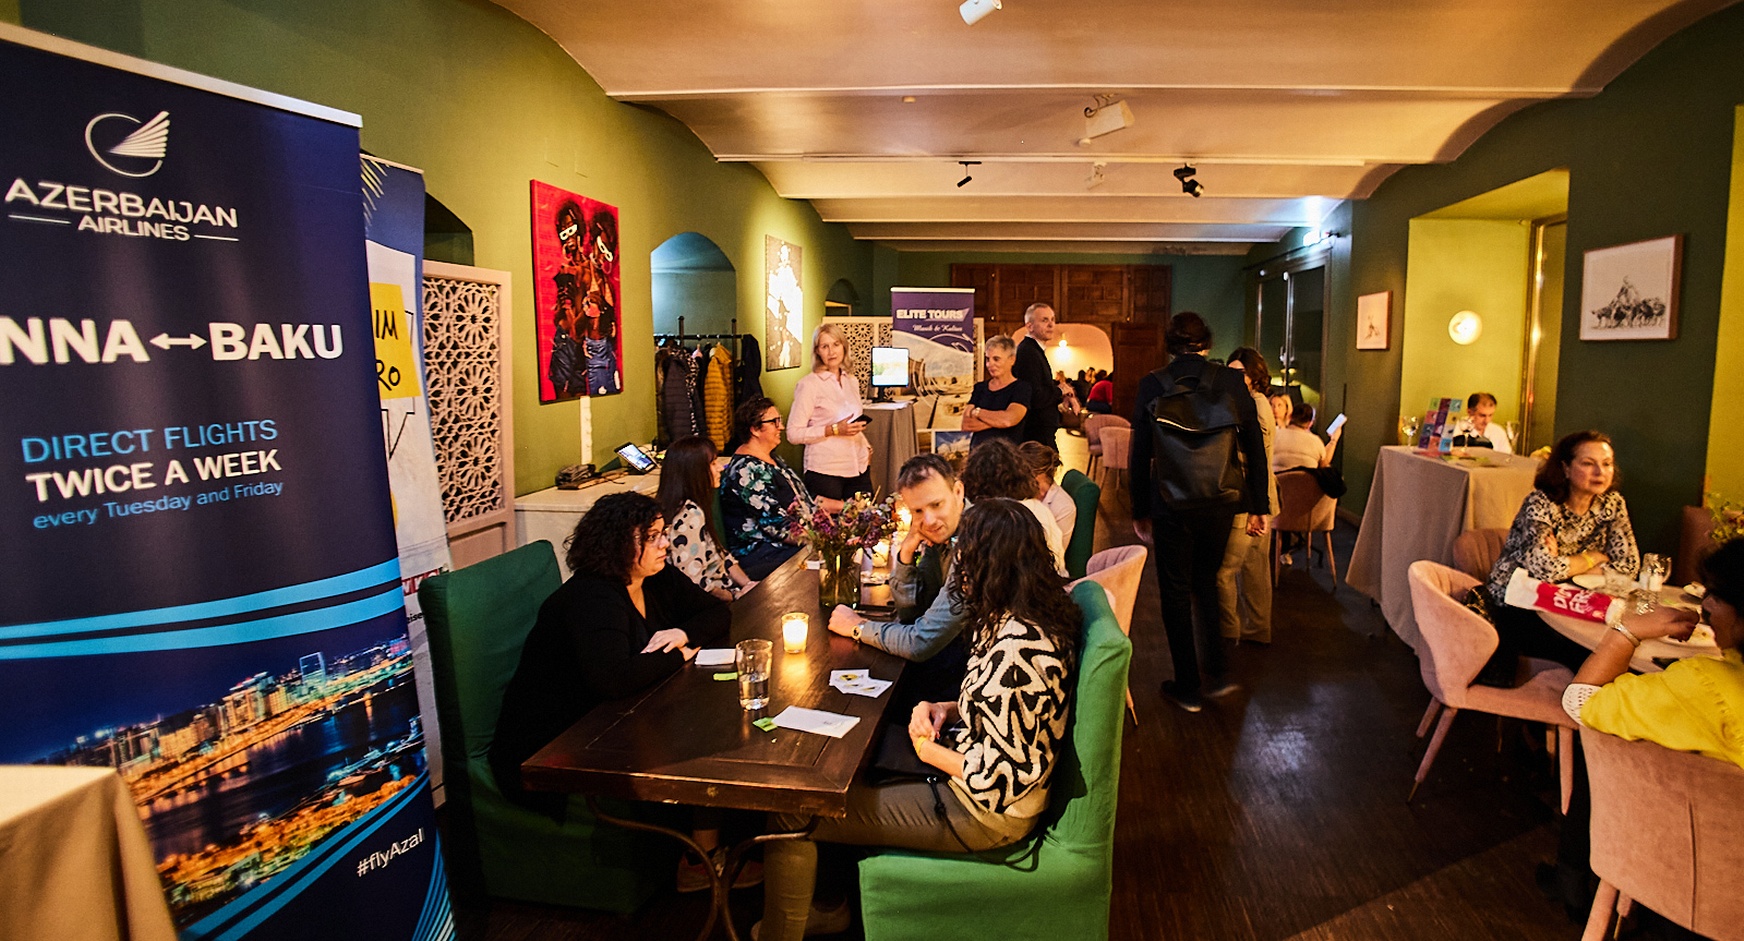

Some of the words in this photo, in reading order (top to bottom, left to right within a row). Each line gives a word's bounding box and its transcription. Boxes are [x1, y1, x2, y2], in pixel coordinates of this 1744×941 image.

[5, 178, 239, 229] AZERBAIJAN
[78, 215, 190, 242] AIRLINES
[896, 309, 926, 319] ELITE
[927, 309, 964, 319] TOURS
[0, 316, 150, 365] NNA
[209, 322, 343, 361] BAKU
[21, 429, 154, 463] DIRECT
[164, 419, 279, 450] FLIGHTS
[25, 462, 157, 503] TWICE
[164, 459, 190, 486] A
[193, 449, 282, 481] WEEK
[33, 507, 99, 529] every
[103, 494, 193, 518] Tuesday
[196, 486, 231, 505] and
[234, 481, 284, 501] Friday
[356, 827, 425, 877] #flyAzal
